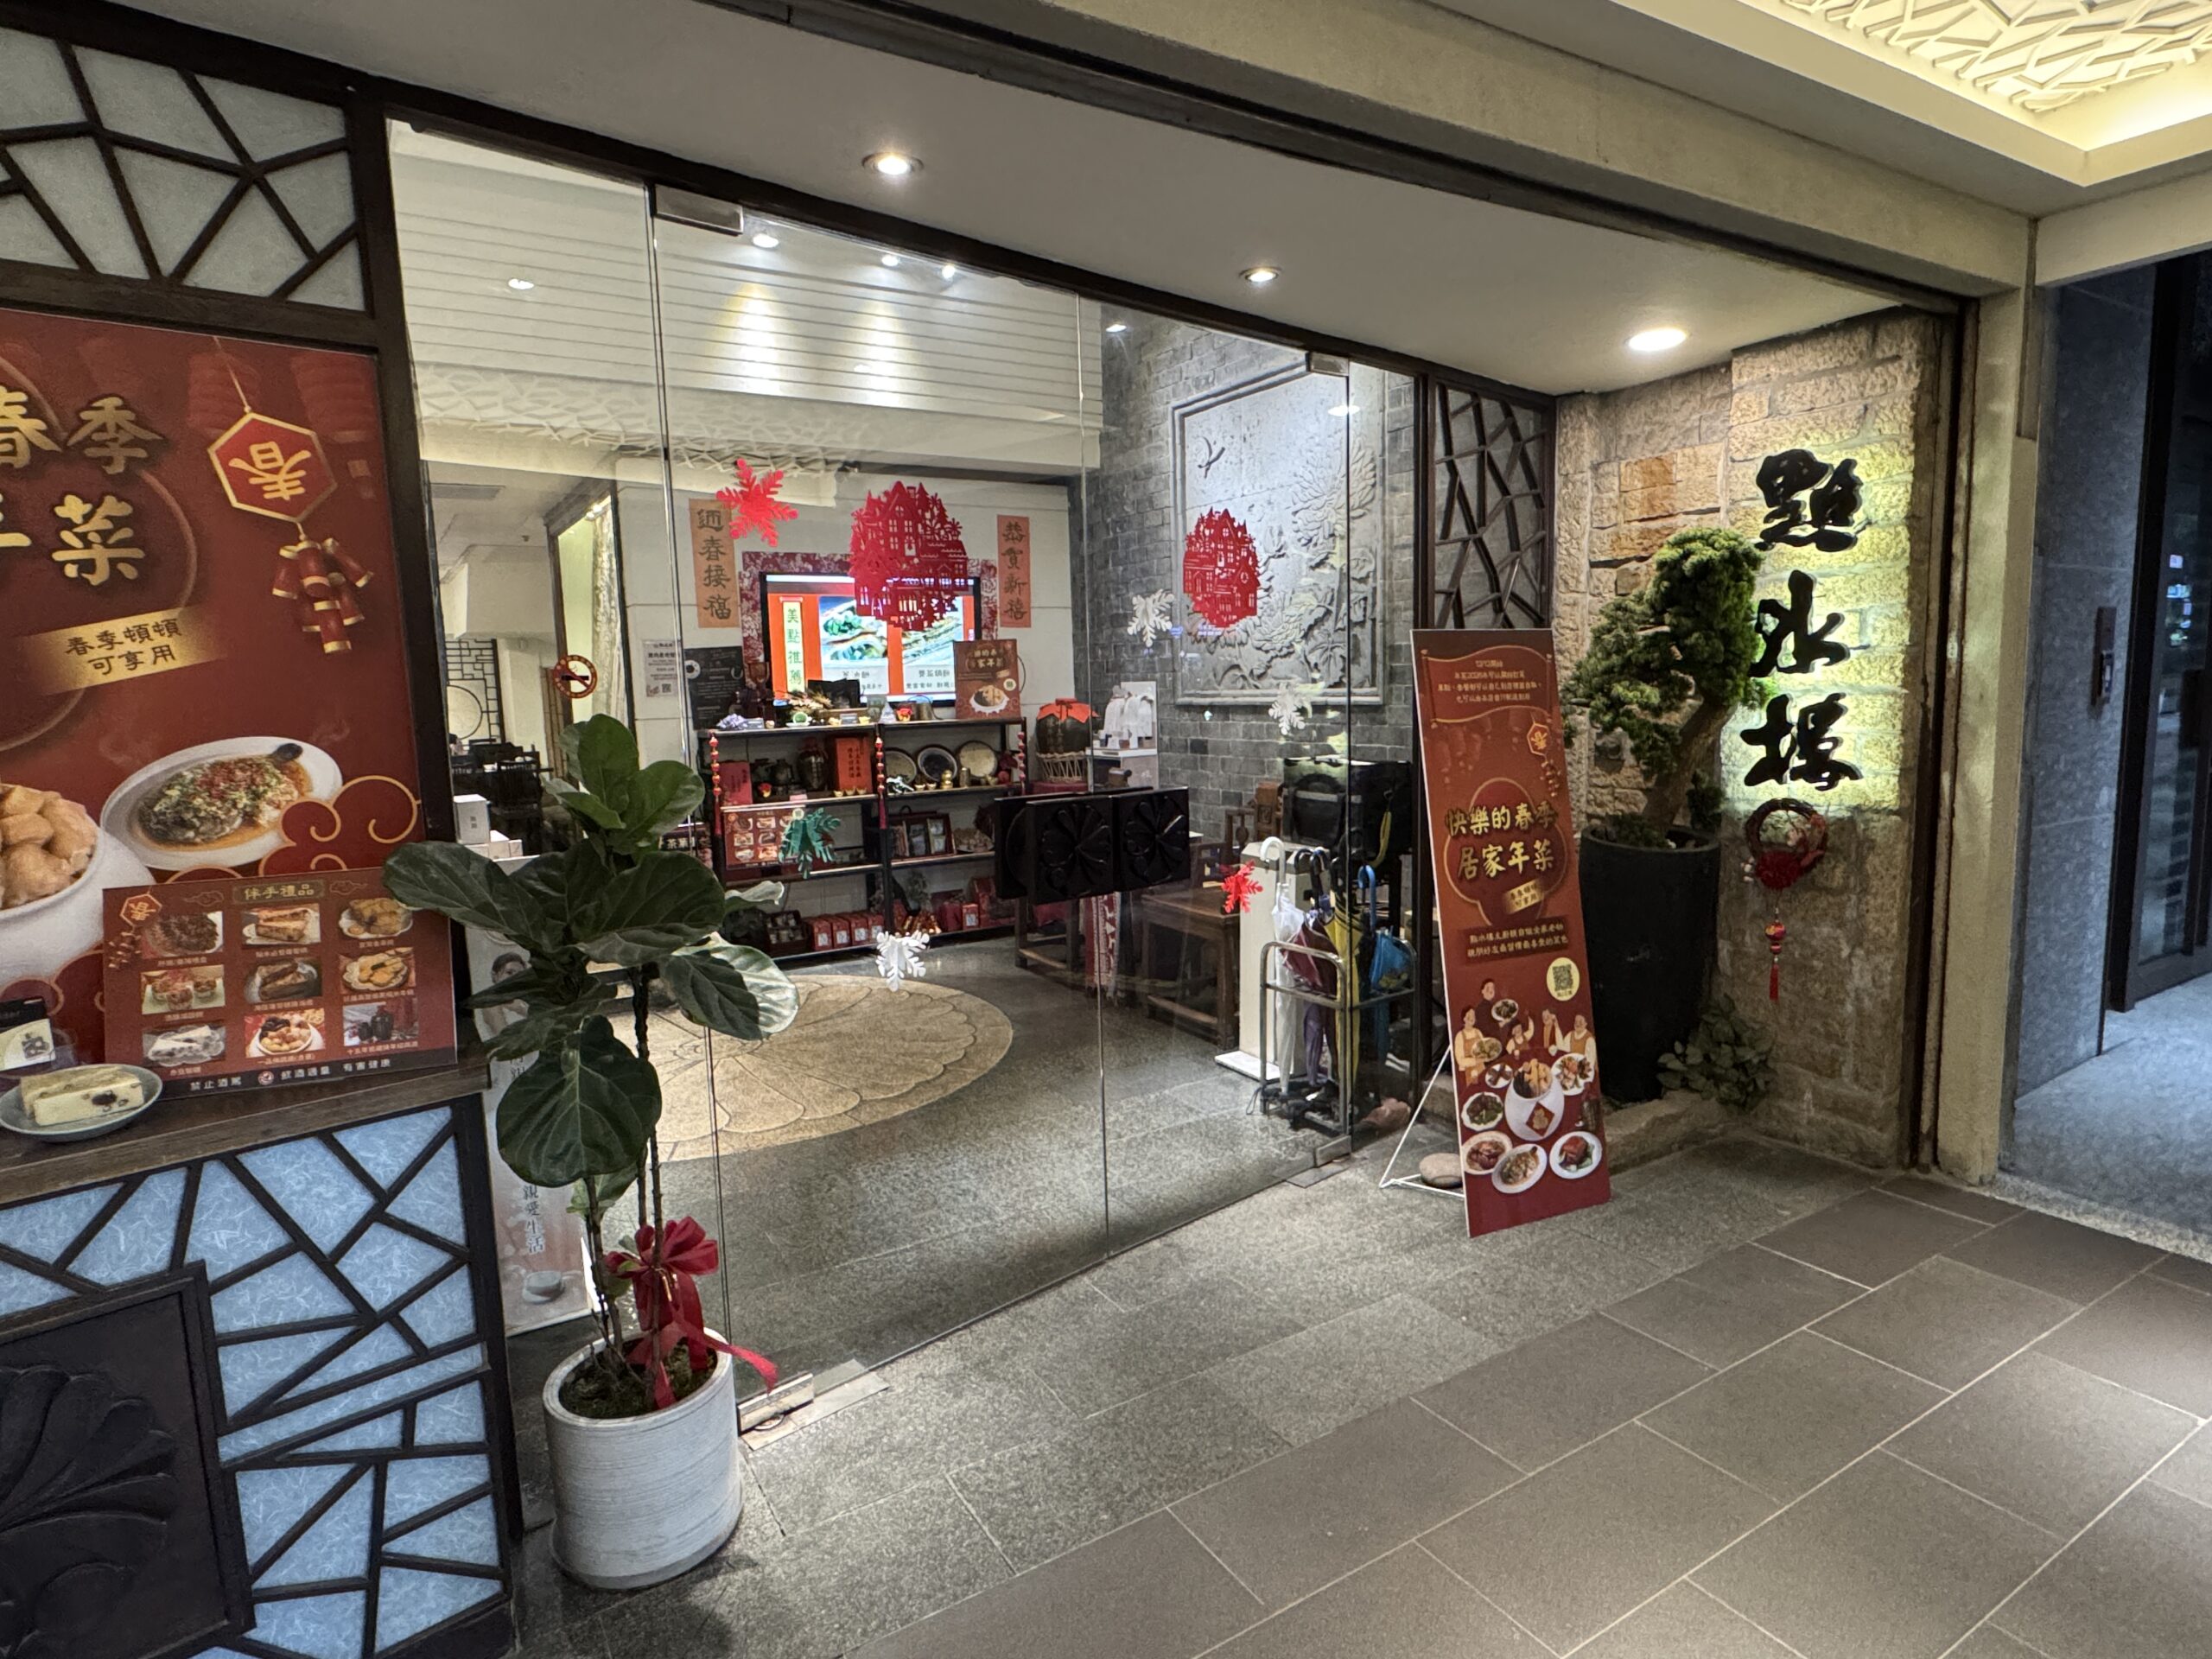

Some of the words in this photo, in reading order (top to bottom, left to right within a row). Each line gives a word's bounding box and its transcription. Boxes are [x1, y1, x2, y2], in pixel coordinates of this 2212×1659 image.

[228, 441, 312, 500] 春
[696, 508, 732, 620] 迎春接福
[1001, 521, 1028, 620] 恭賀新禧
[65, 618, 183, 656] 春季頓頓
[787, 608, 803, 685] 美點推薦
[88, 645, 176, 675] 可享用
[1447, 800, 1557, 836] 快樂的春季
[1458, 838, 1555, 880] 居家年菜
[244, 884, 315, 901] 伴手禮品
[190, 1077, 242, 1091] 禁止酒駕
